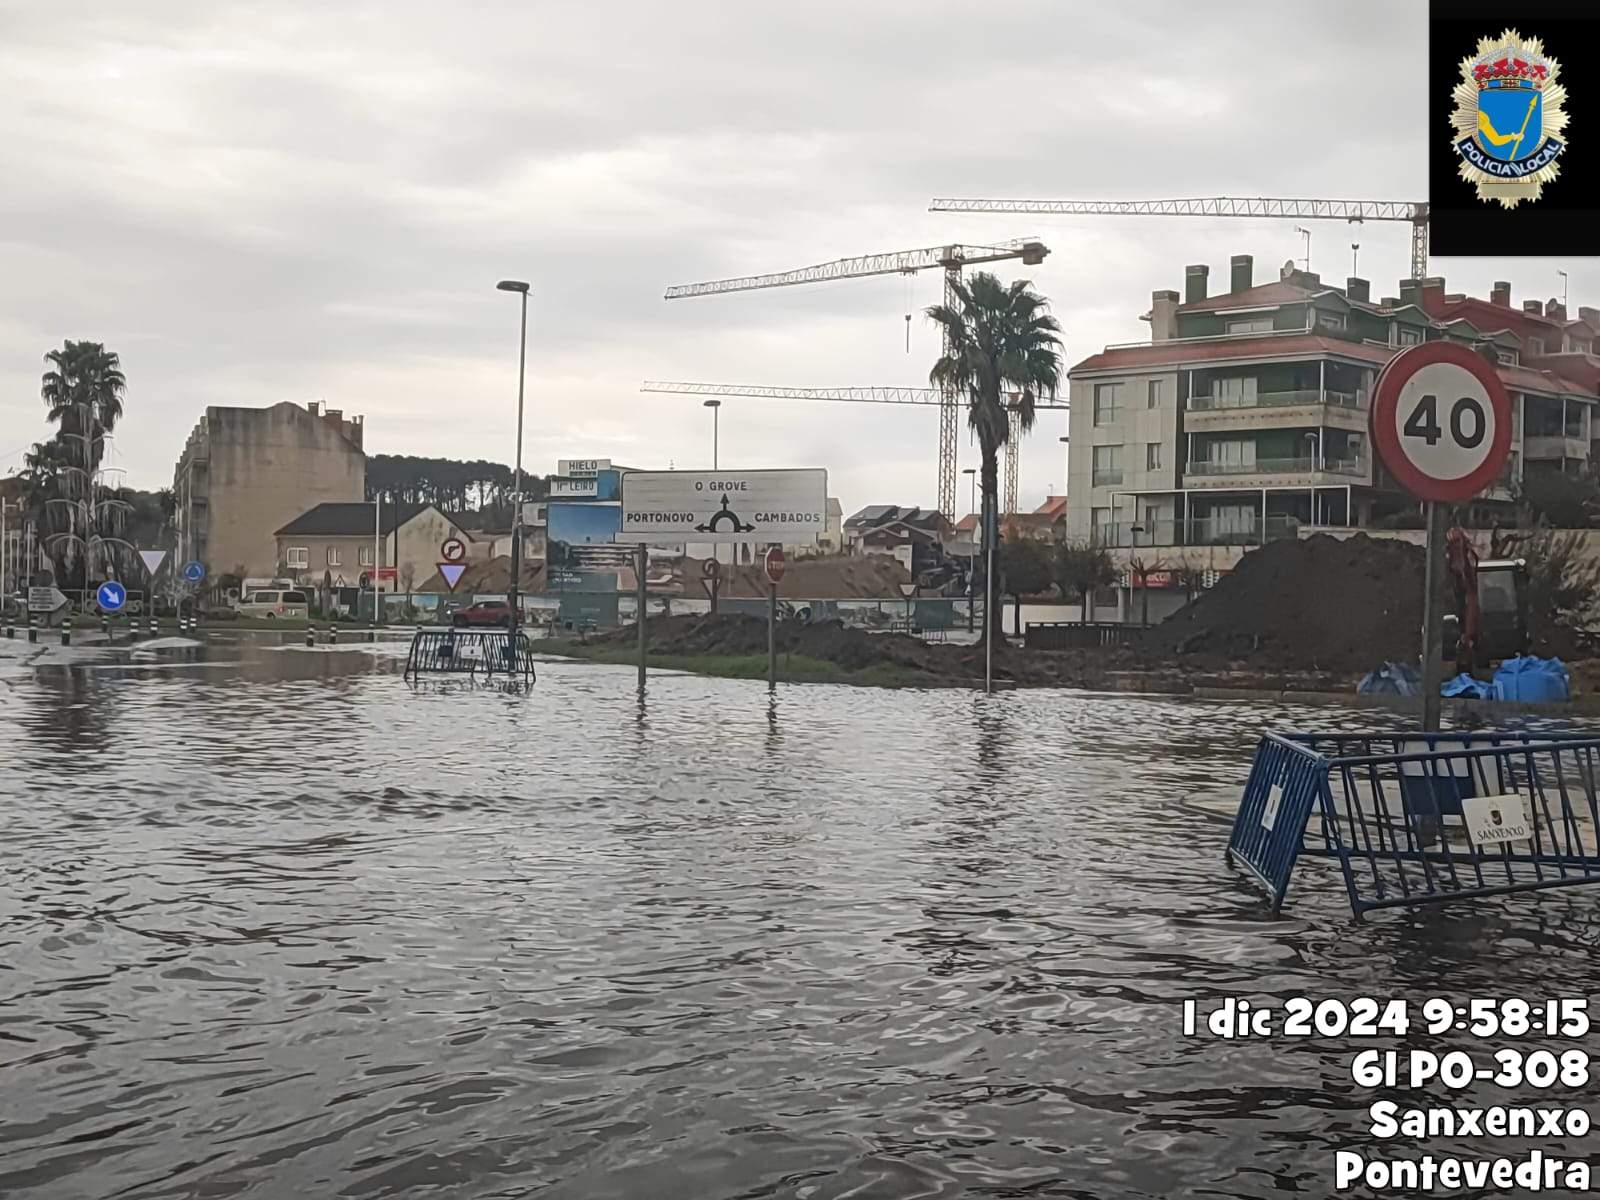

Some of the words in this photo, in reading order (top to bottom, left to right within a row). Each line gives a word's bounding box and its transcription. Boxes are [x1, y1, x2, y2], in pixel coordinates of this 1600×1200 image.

[1404, 395, 1486, 449] 40
[568, 461, 598, 470] HIELO
[695, 482, 703, 491] O
[709, 481, 747, 491] GROVE
[626, 512, 694, 523] PORTONOVO
[754, 512, 820, 523] CAMBADOS
[1477, 826, 1525, 840] SANXENXO
